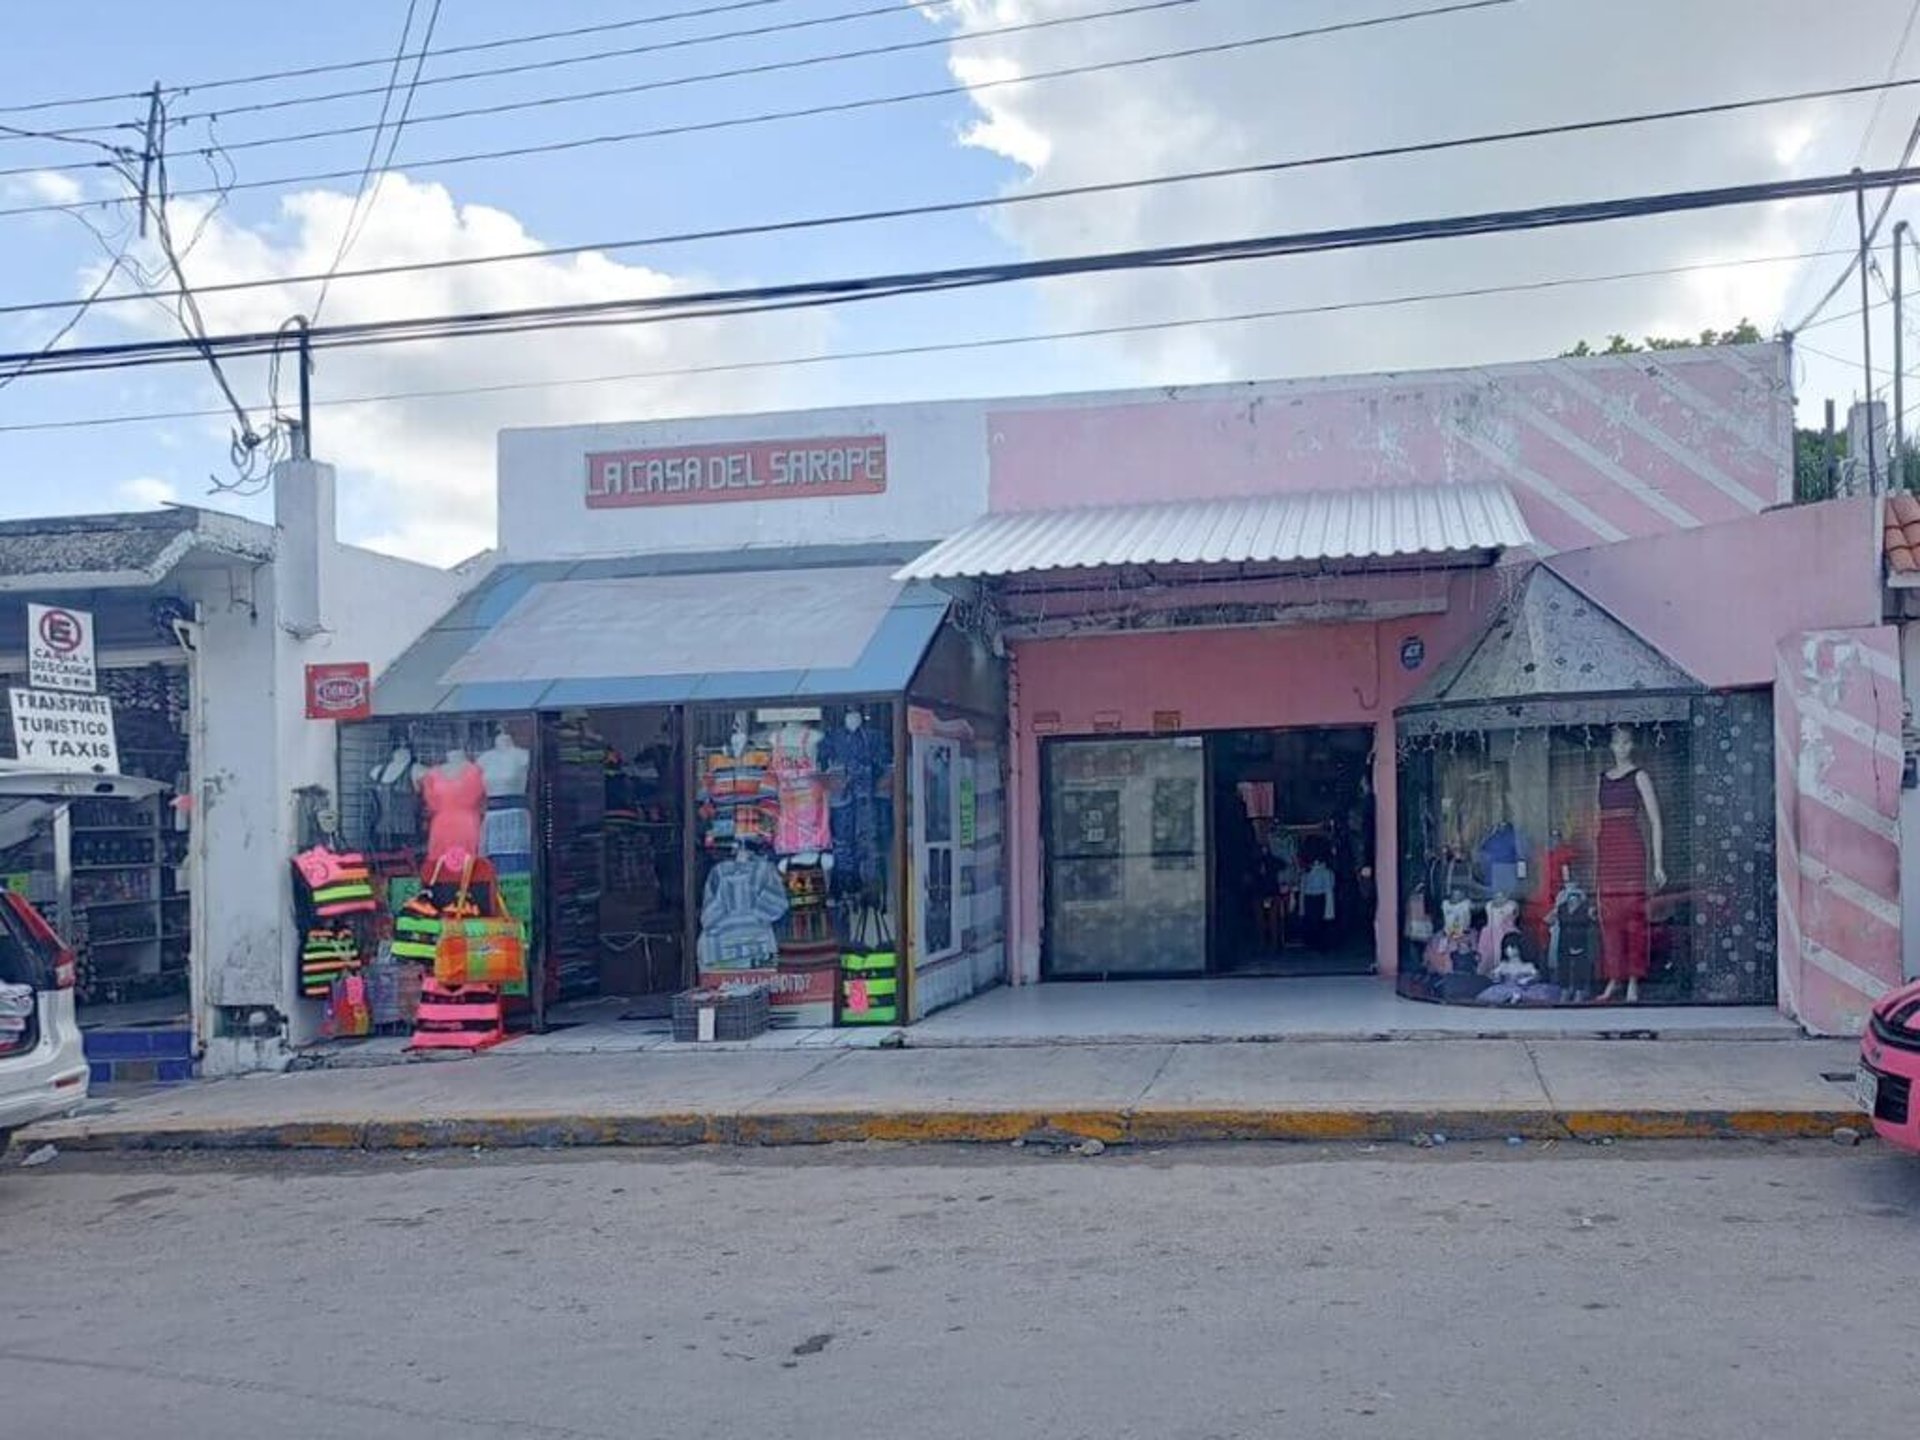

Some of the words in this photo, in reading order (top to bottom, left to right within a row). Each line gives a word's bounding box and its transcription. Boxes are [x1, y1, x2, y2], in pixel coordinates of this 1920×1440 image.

[587, 457, 623, 496] LA
[628, 456, 700, 494] CASA
[708, 452, 765, 491] DEL
[769, 445, 884, 486] SARAPE
[15, 693, 107, 715] TRANSPORTE
[18, 717, 108, 736] TURISTICO
[21, 740, 34, 755] Y
[47, 740, 111, 759] TAXIS
